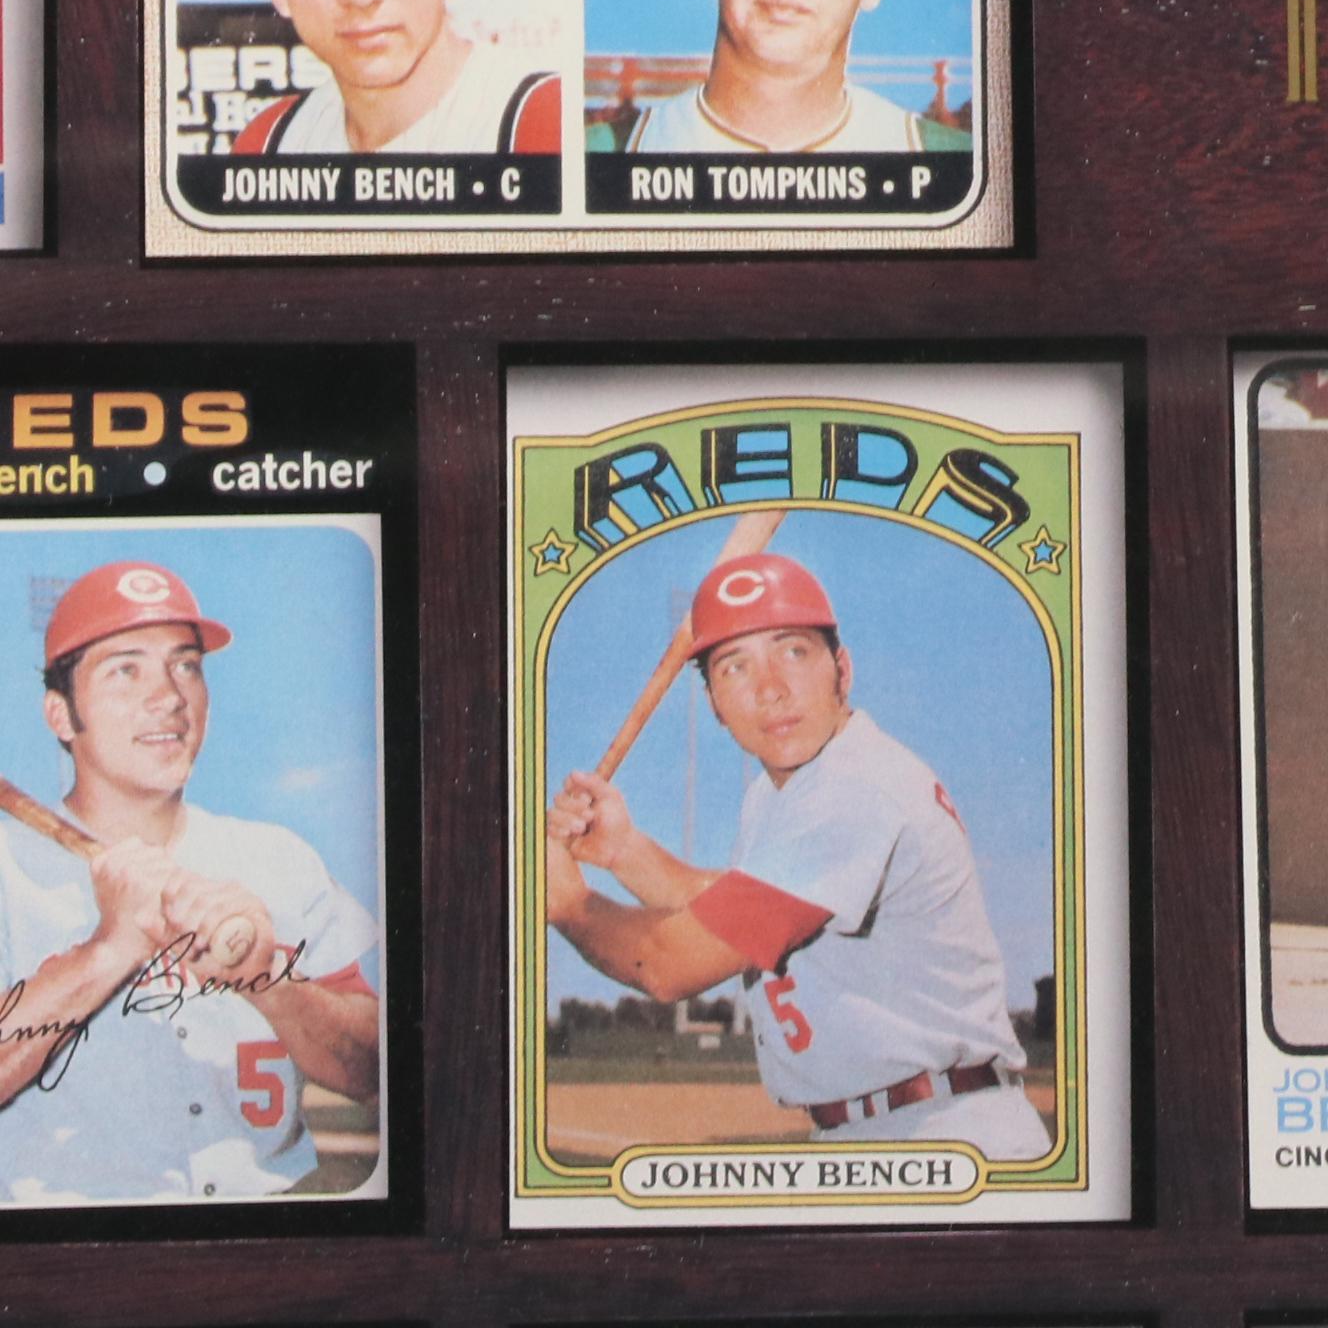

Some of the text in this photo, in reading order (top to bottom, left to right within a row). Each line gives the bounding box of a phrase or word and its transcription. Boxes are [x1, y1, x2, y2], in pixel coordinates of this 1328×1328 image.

[221, 166, 521, 203] JOHNNY BENCH C
[631, 166, 932, 200] RON TOMPKINS P
[12, 391, 250, 449] EDS
[212, 451, 373, 492] catcher
[573, 421, 1032, 557] REDS
[122, 931, 311, 1020] Bench
[763, 975, 814, 1054] 5
[236, 1039, 291, 1129] 5
[641, 1158, 954, 1190] JOHNNY BENCH
